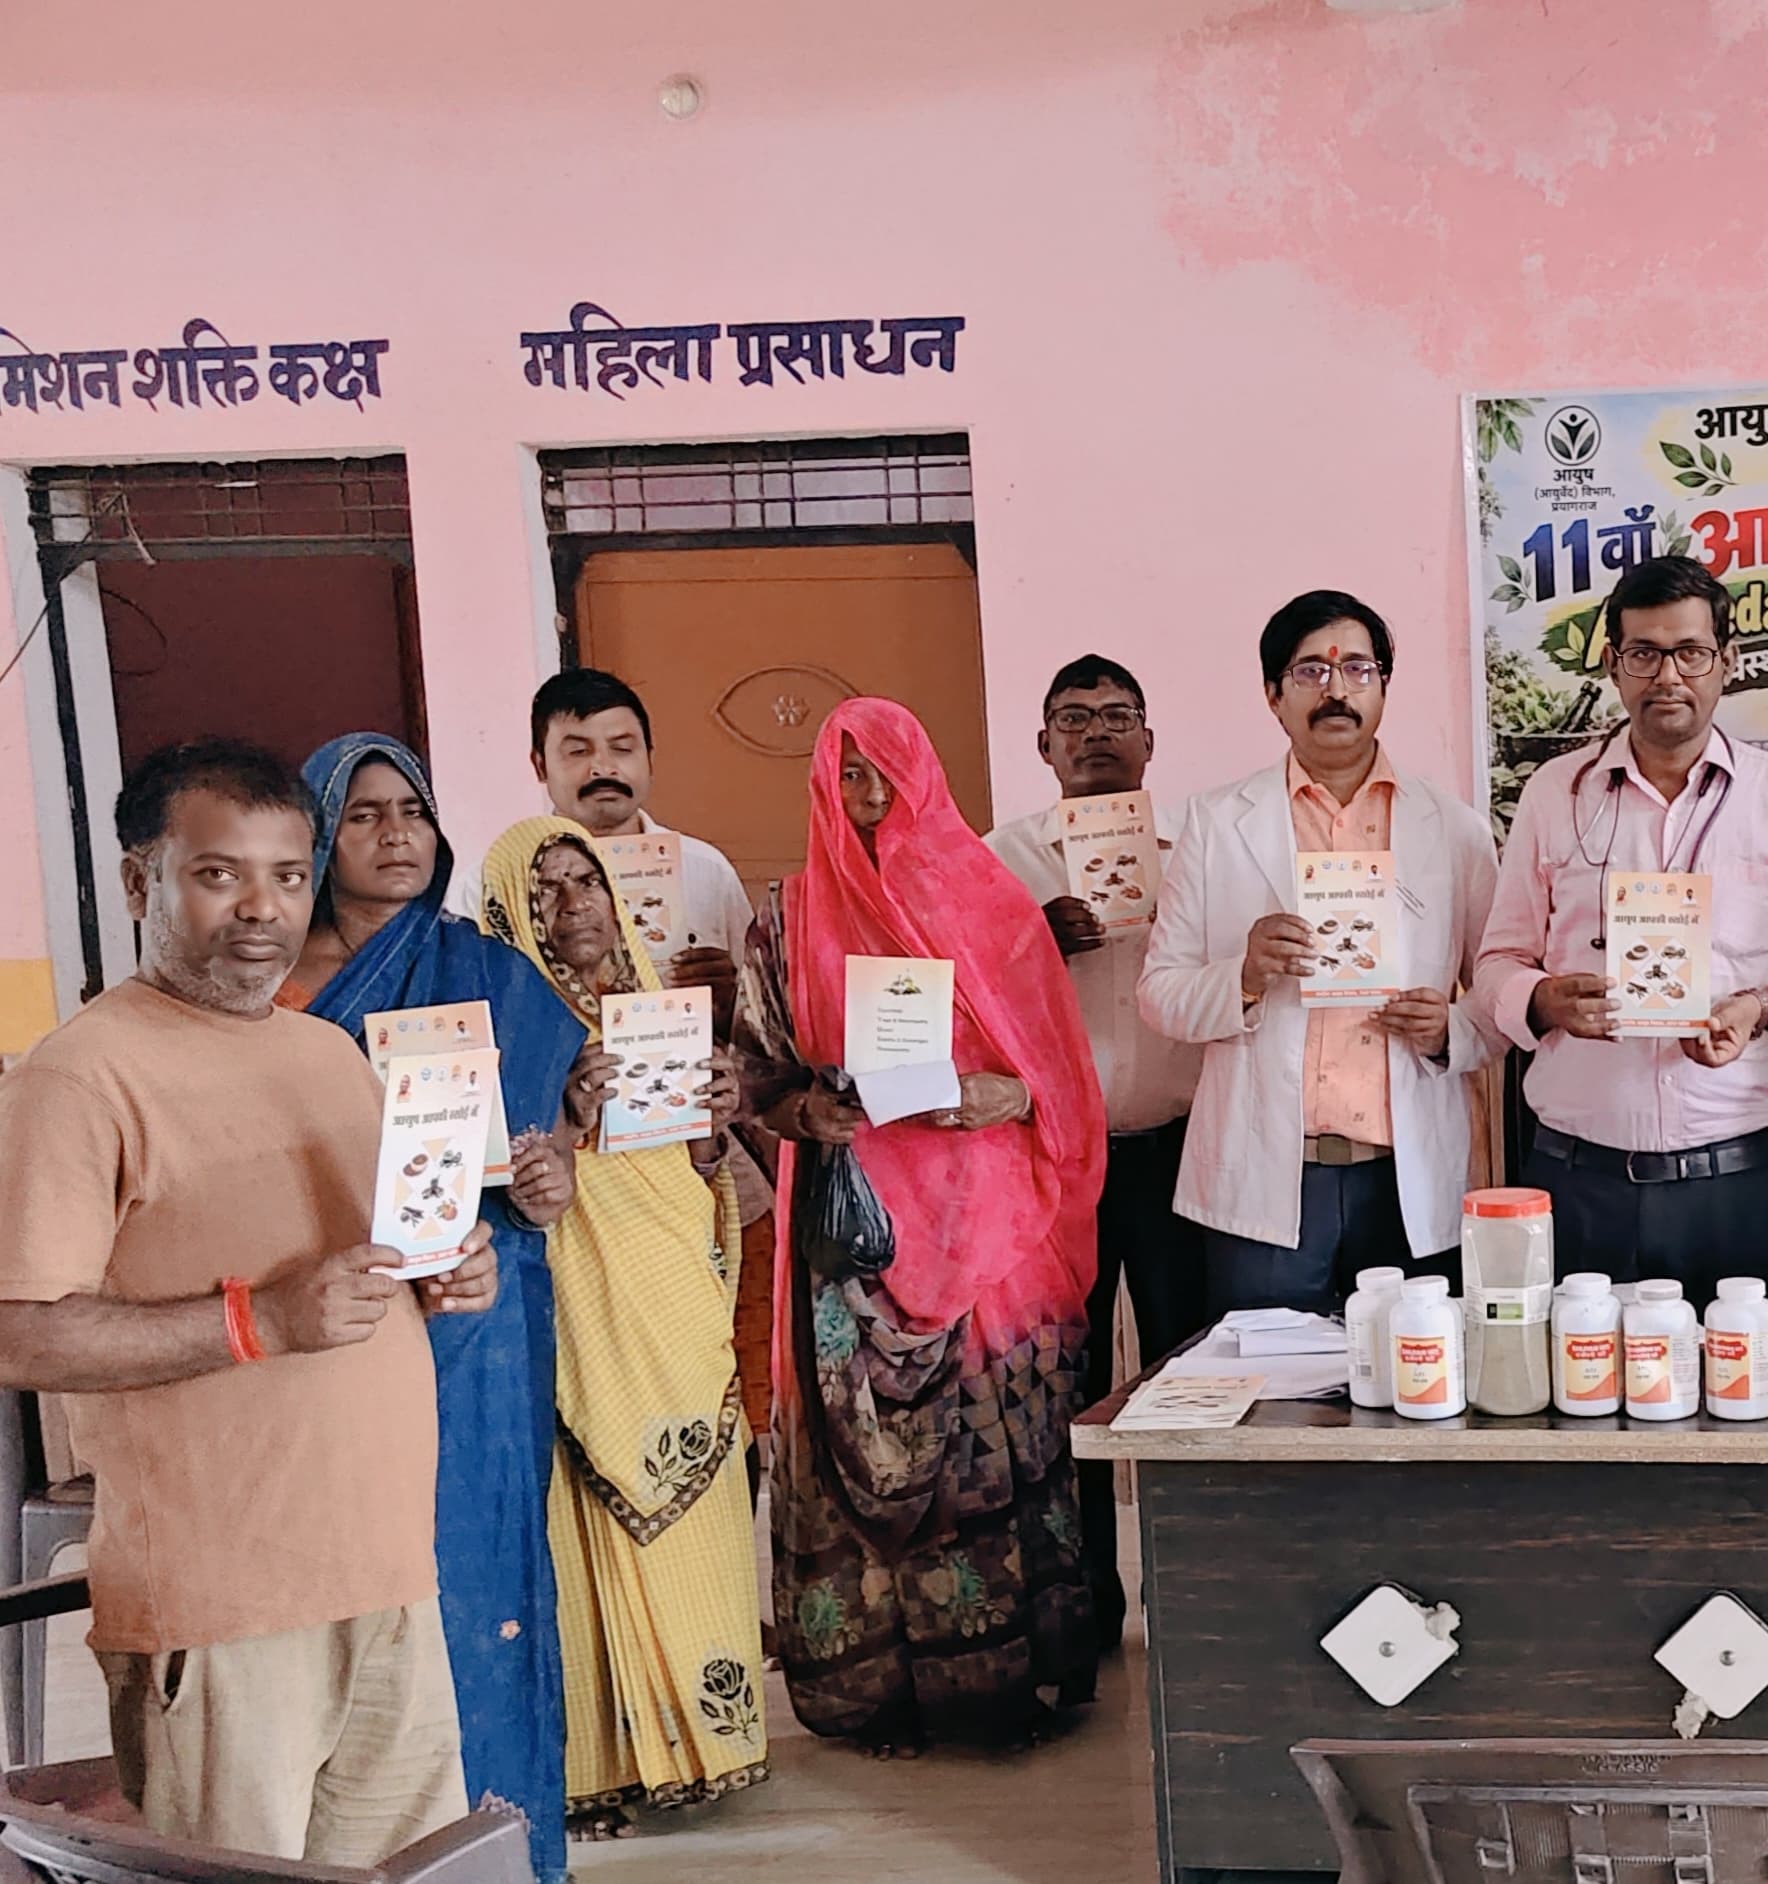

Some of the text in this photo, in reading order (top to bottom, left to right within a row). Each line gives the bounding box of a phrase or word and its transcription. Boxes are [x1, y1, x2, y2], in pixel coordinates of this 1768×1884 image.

[131, 317, 258, 409] शक्ति
[268, 338, 390, 413] कक्ष
[520, 302, 965, 401] महिला प्रसाधन
[1553, 467, 1594, 483] आयुष
